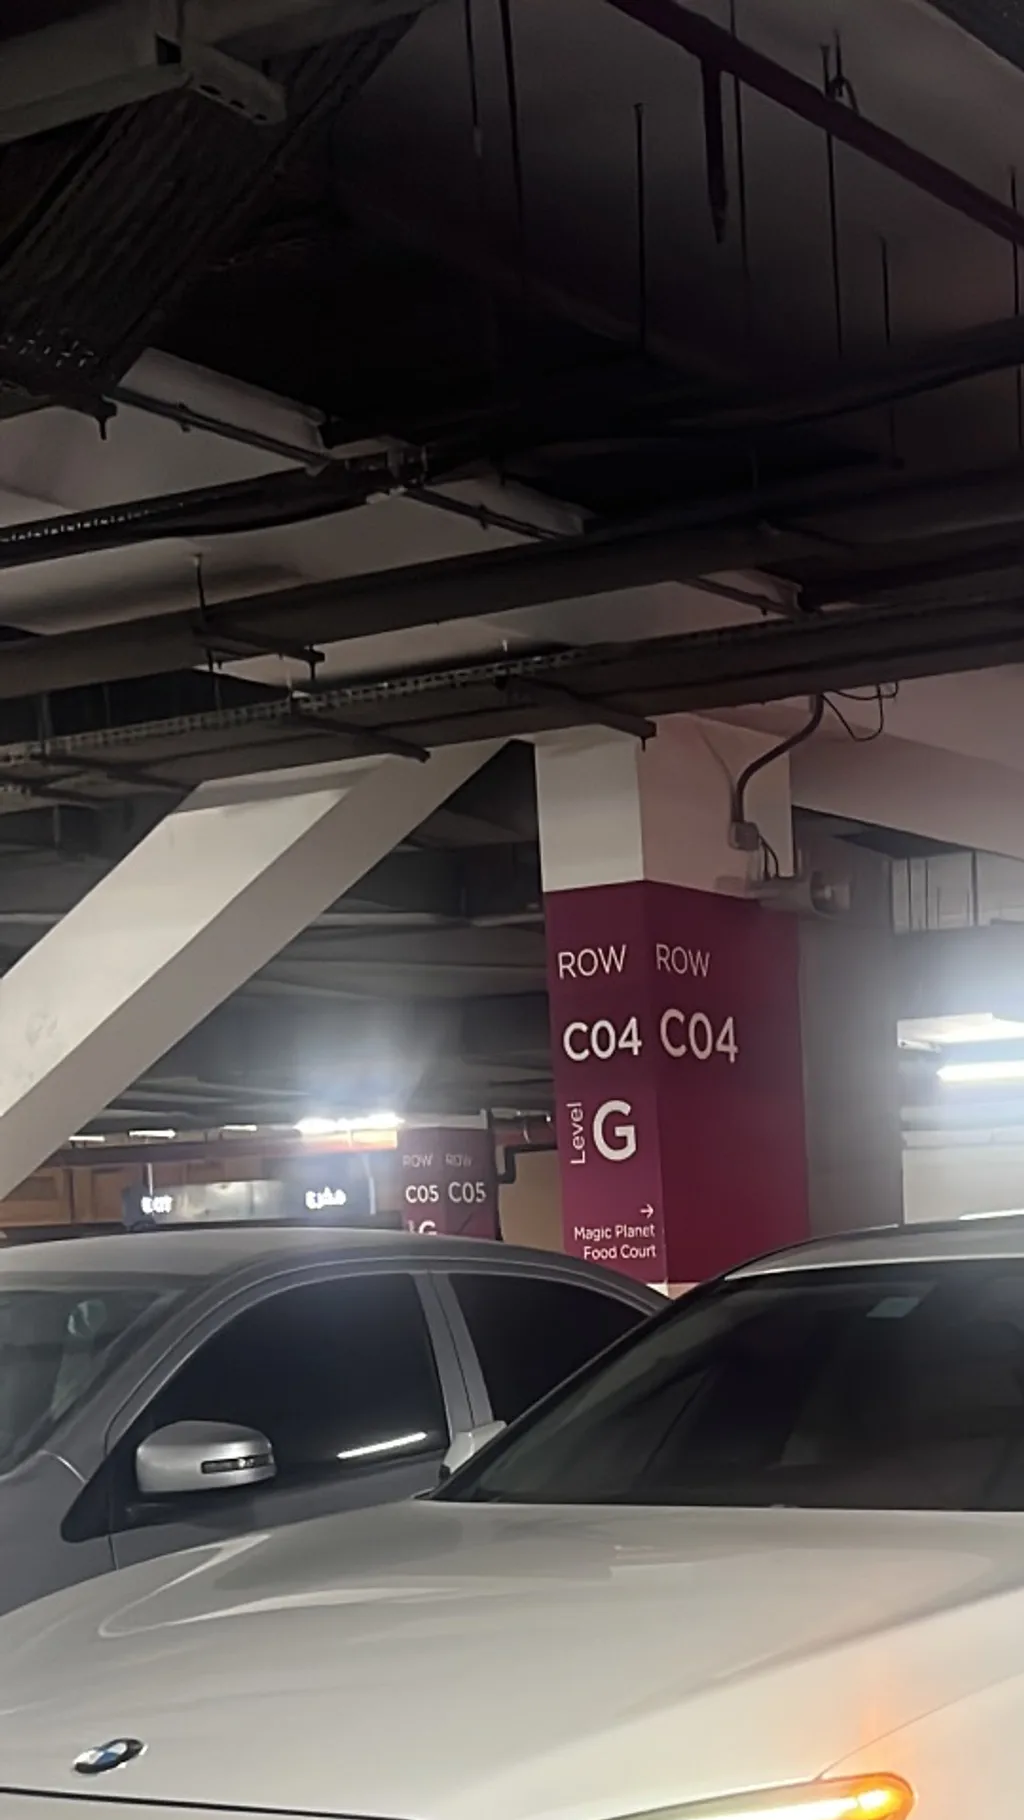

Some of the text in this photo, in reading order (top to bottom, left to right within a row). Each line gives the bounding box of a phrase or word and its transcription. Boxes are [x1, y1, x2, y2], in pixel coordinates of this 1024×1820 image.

[557, 945, 627, 979] ROW
[655, 943, 710, 978] ROW
[563, 1016, 642, 1062] C04
[659, 1008, 739, 1064] C04
[566, 1101, 586, 1164] Level
[592, 1099, 637, 1161] G
[402, 1152, 434, 1168] ROW
[405, 1184, 440, 1204] C05
[448, 1181, 487, 1204] C05
[574, 1224, 655, 1243] Magic Planet
[583, 1243, 656, 1260] Food Court
